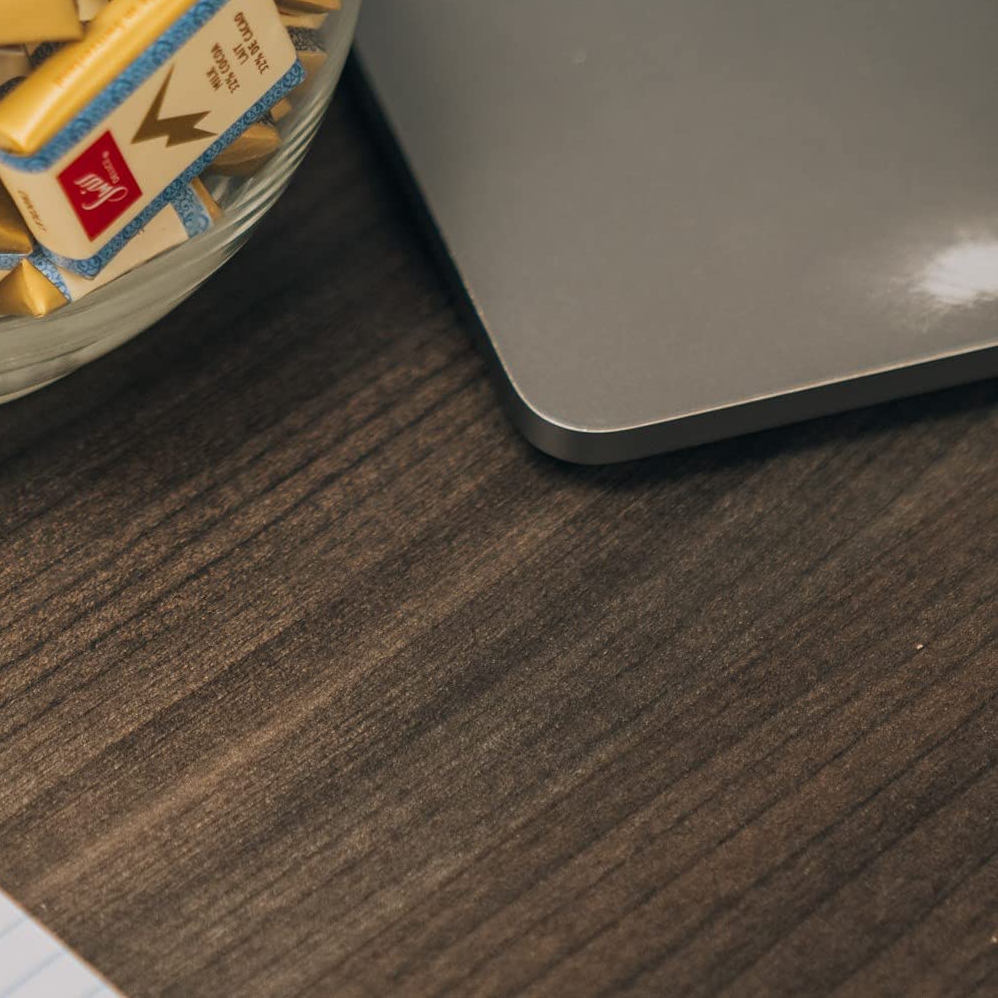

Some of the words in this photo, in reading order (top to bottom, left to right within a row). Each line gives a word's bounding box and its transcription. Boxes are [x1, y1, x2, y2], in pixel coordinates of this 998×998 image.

[234, 11, 253, 42] CACAO
[211, 42, 230, 74] COCOA
[232, 43, 249, 65] LAIT
[247, 39, 260, 56] DE
[254, 53, 269, 75] 32%
